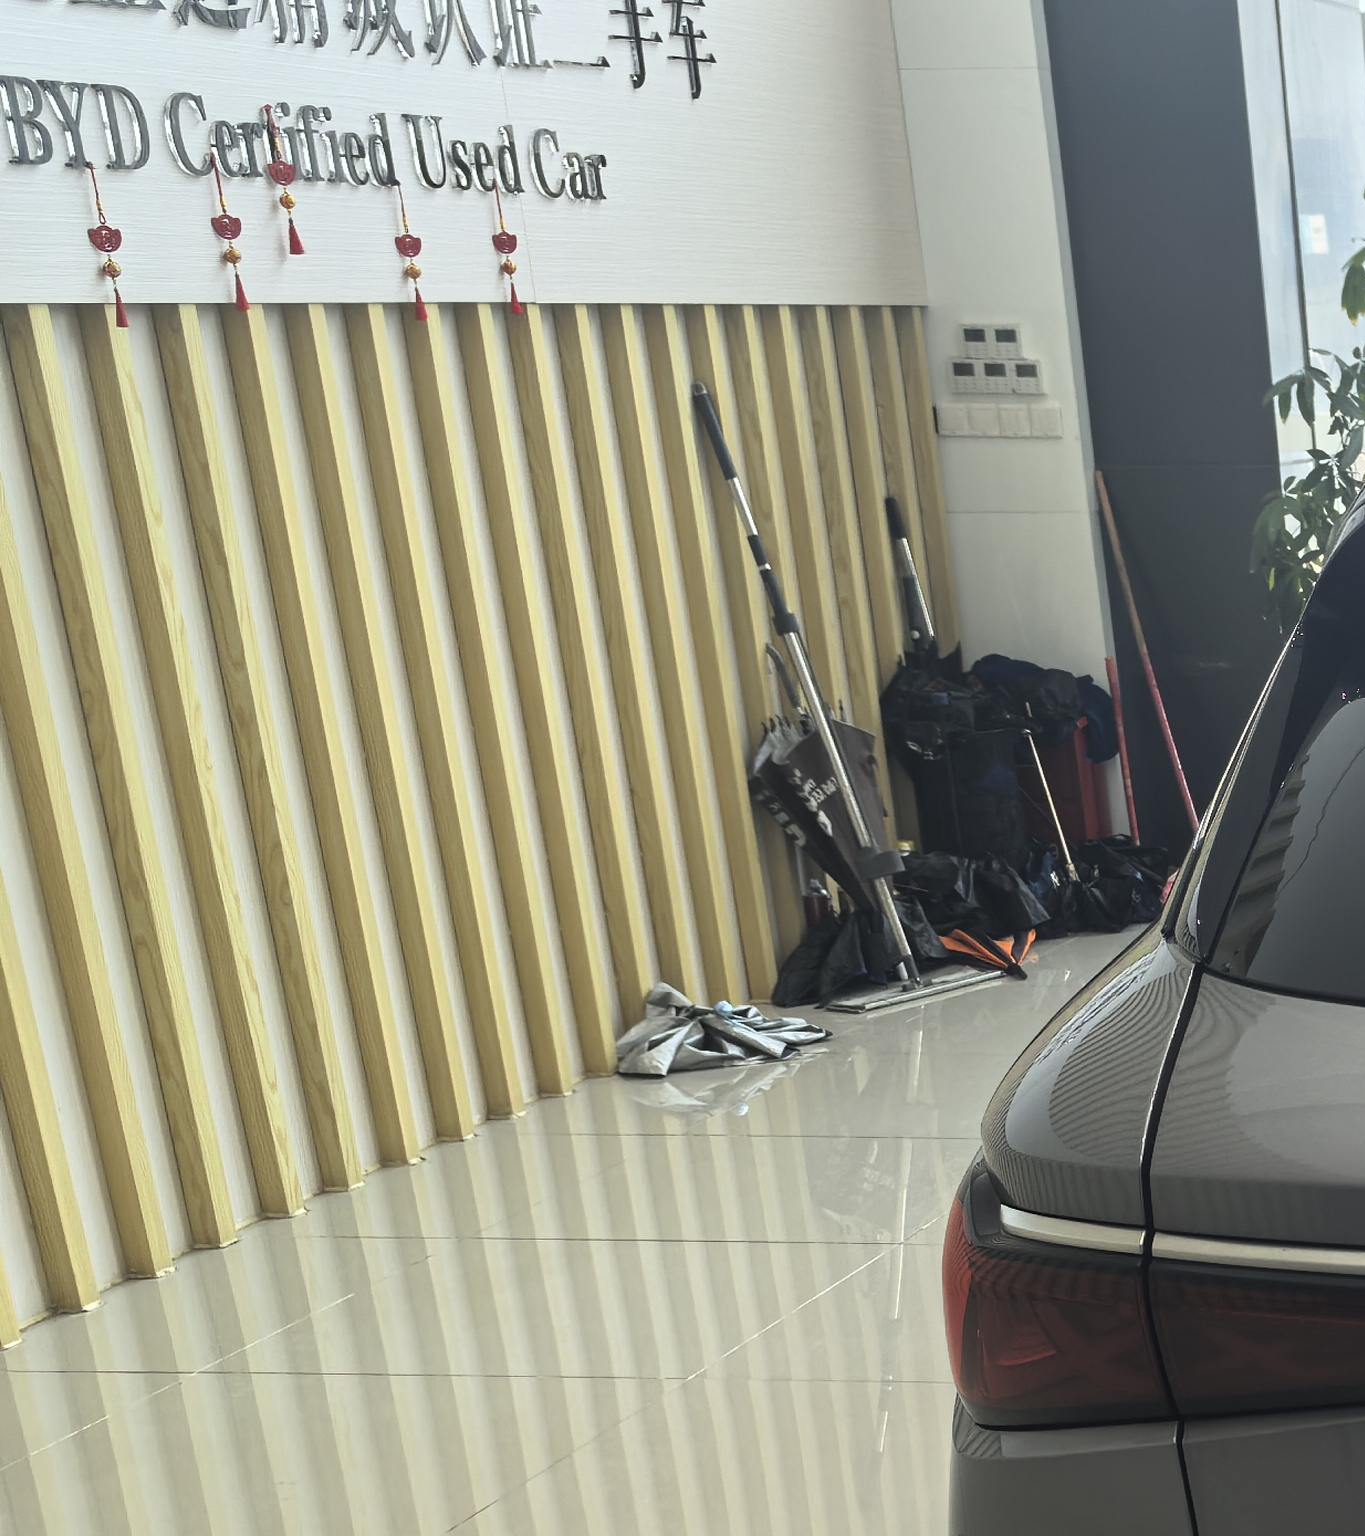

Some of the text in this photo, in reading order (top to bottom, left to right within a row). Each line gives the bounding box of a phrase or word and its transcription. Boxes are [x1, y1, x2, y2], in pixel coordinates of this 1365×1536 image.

[0, 74, 607, 201] BYD Certified Used Car
